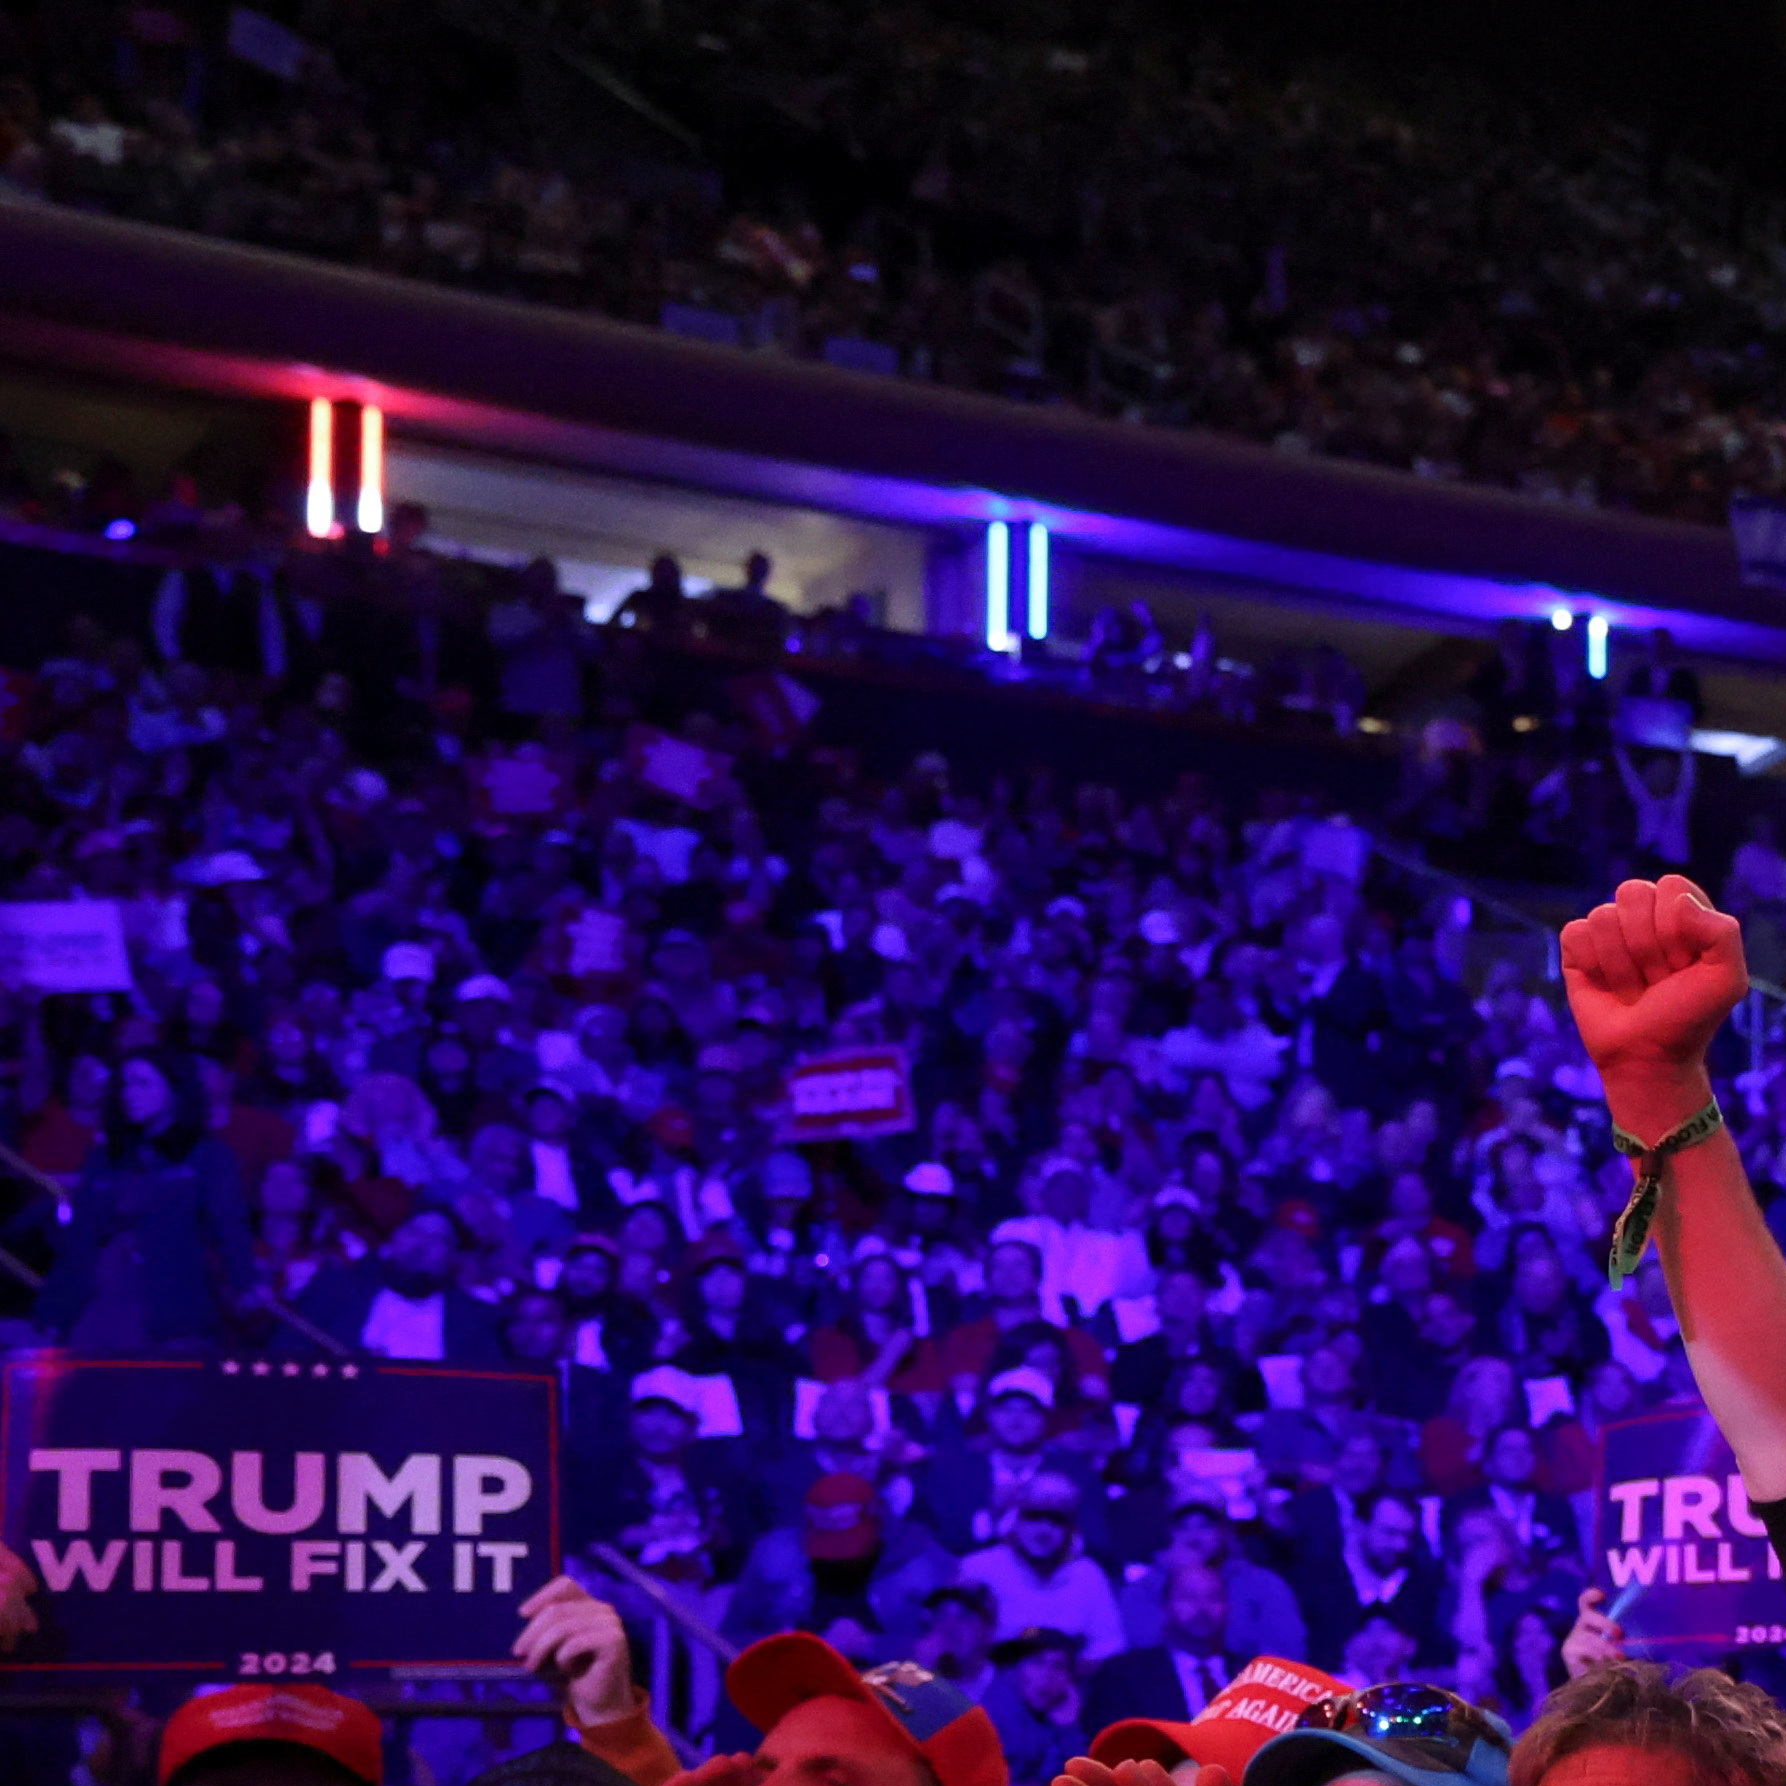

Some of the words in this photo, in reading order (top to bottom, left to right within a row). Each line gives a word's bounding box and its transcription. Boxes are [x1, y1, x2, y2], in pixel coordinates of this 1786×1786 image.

[29, 1448, 532, 1535] TRUMP
[31, 1539, 264, 1592] WILL
[290, 1541, 427, 1592] FIX
[453, 1542, 528, 1592] IT
[1607, 1542, 1751, 1587] WILL
[238, 1651, 336, 1675] 2024
